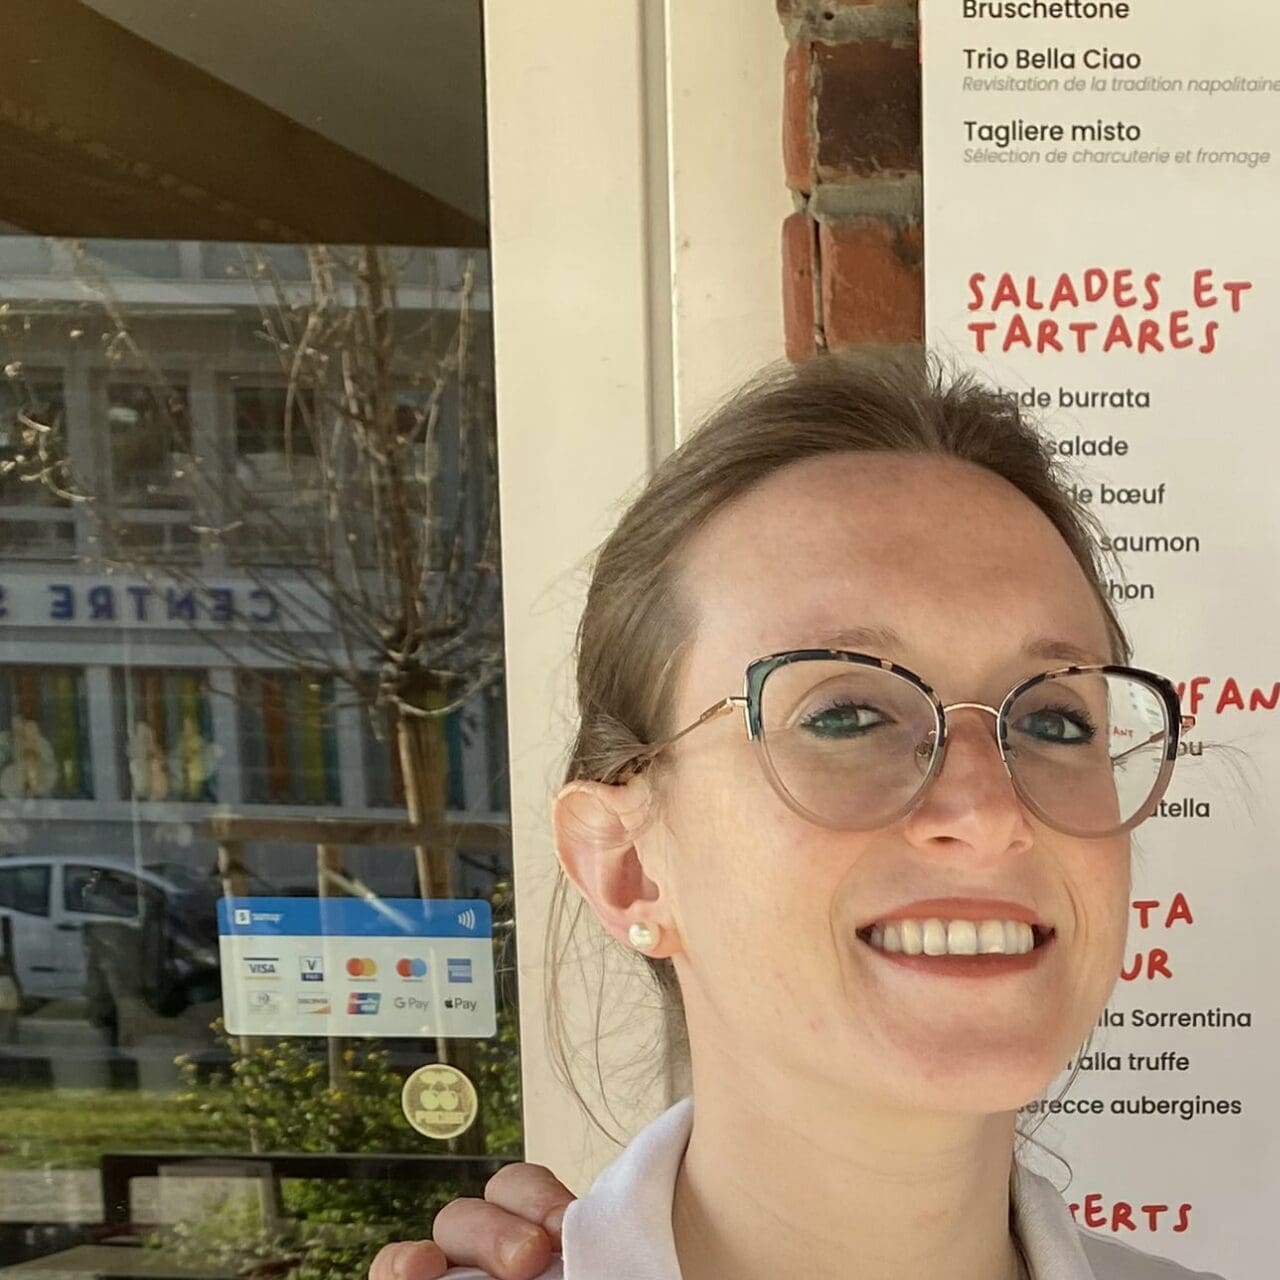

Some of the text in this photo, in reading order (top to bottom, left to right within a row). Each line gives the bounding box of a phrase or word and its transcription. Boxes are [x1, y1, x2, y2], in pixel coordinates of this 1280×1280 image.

[963, 0, 1129, 18] Bruschettone
[963, 47, 1141, 69] Trio Bella Ciao
[963, 75, 1059, 91] Revisitation
[1063, 76, 1086, 92] de
[1091, 76, 1107, 91] la
[1111, 76, 1182, 91] tradition
[964, 119, 1140, 148] Tagliere misto
[963, 146, 1270, 168] Sélection de charcuterie et fromage
[967, 268, 1252, 312] SALADES ET
[967, 310, 1219, 354] TARTARES
[1059, 387, 1149, 408] burrata
[1048, 435, 1129, 456] salade
[1101, 483, 1165, 504] bœuf
[1101, 536, 1200, 552] saumon
[249, 964, 276, 974] VISA
[408, 998, 430, 1012] Pay
[455, 998, 477, 1012] Pay
[1132, 1008, 1251, 1027] Sorrentina
[1080, 1052, 1121, 1071] alla
[1128, 1052, 1189, 1071] truffe
[1111, 1095, 1241, 1120] aubergines
